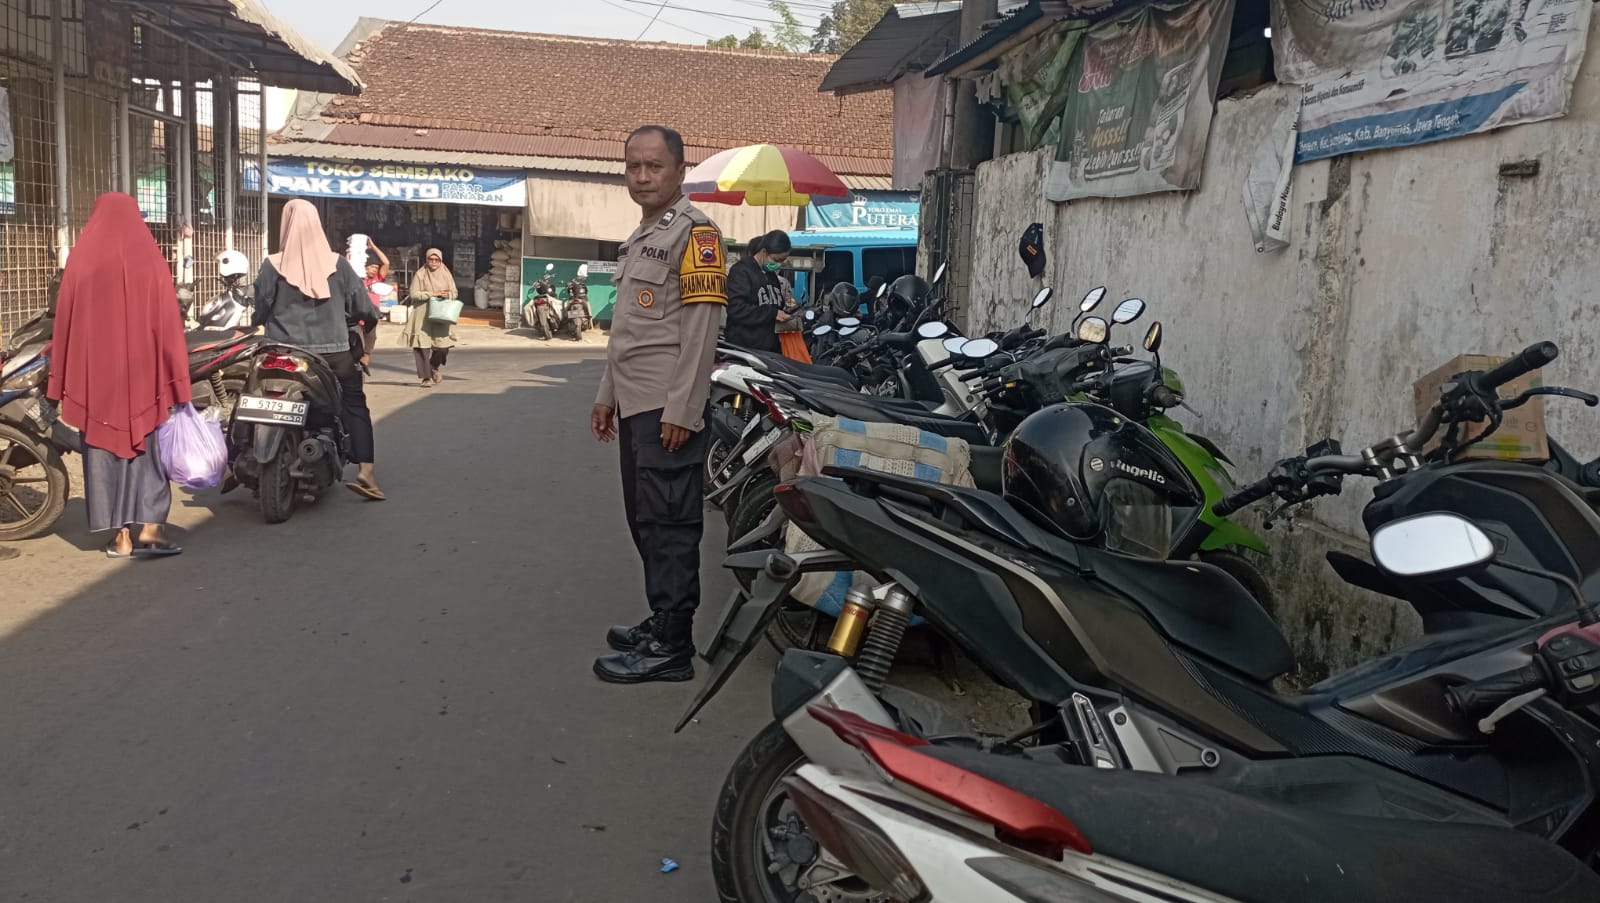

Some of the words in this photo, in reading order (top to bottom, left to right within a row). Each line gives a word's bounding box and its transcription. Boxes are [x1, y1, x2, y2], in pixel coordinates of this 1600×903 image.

[1354, 125, 1372, 141] Kab.
[1413, 117, 1433, 133] Jawa
[305, 161, 363, 178] TOKO
[367, 162, 475, 182] SEMBAKO
[270, 173, 334, 195] PAK
[339, 176, 440, 201] KANTO
[442, 182, 484, 193] PASAR
[442, 190, 504, 203] BANARAN
[852, 206, 918, 227] PUTERA
[1271, 201, 1287, 231] Budaya
[641, 246, 669, 261] POLRI
[241, 398, 249, 408] R
[258, 399, 284, 411] 5379
[291, 403, 305, 414] PG
